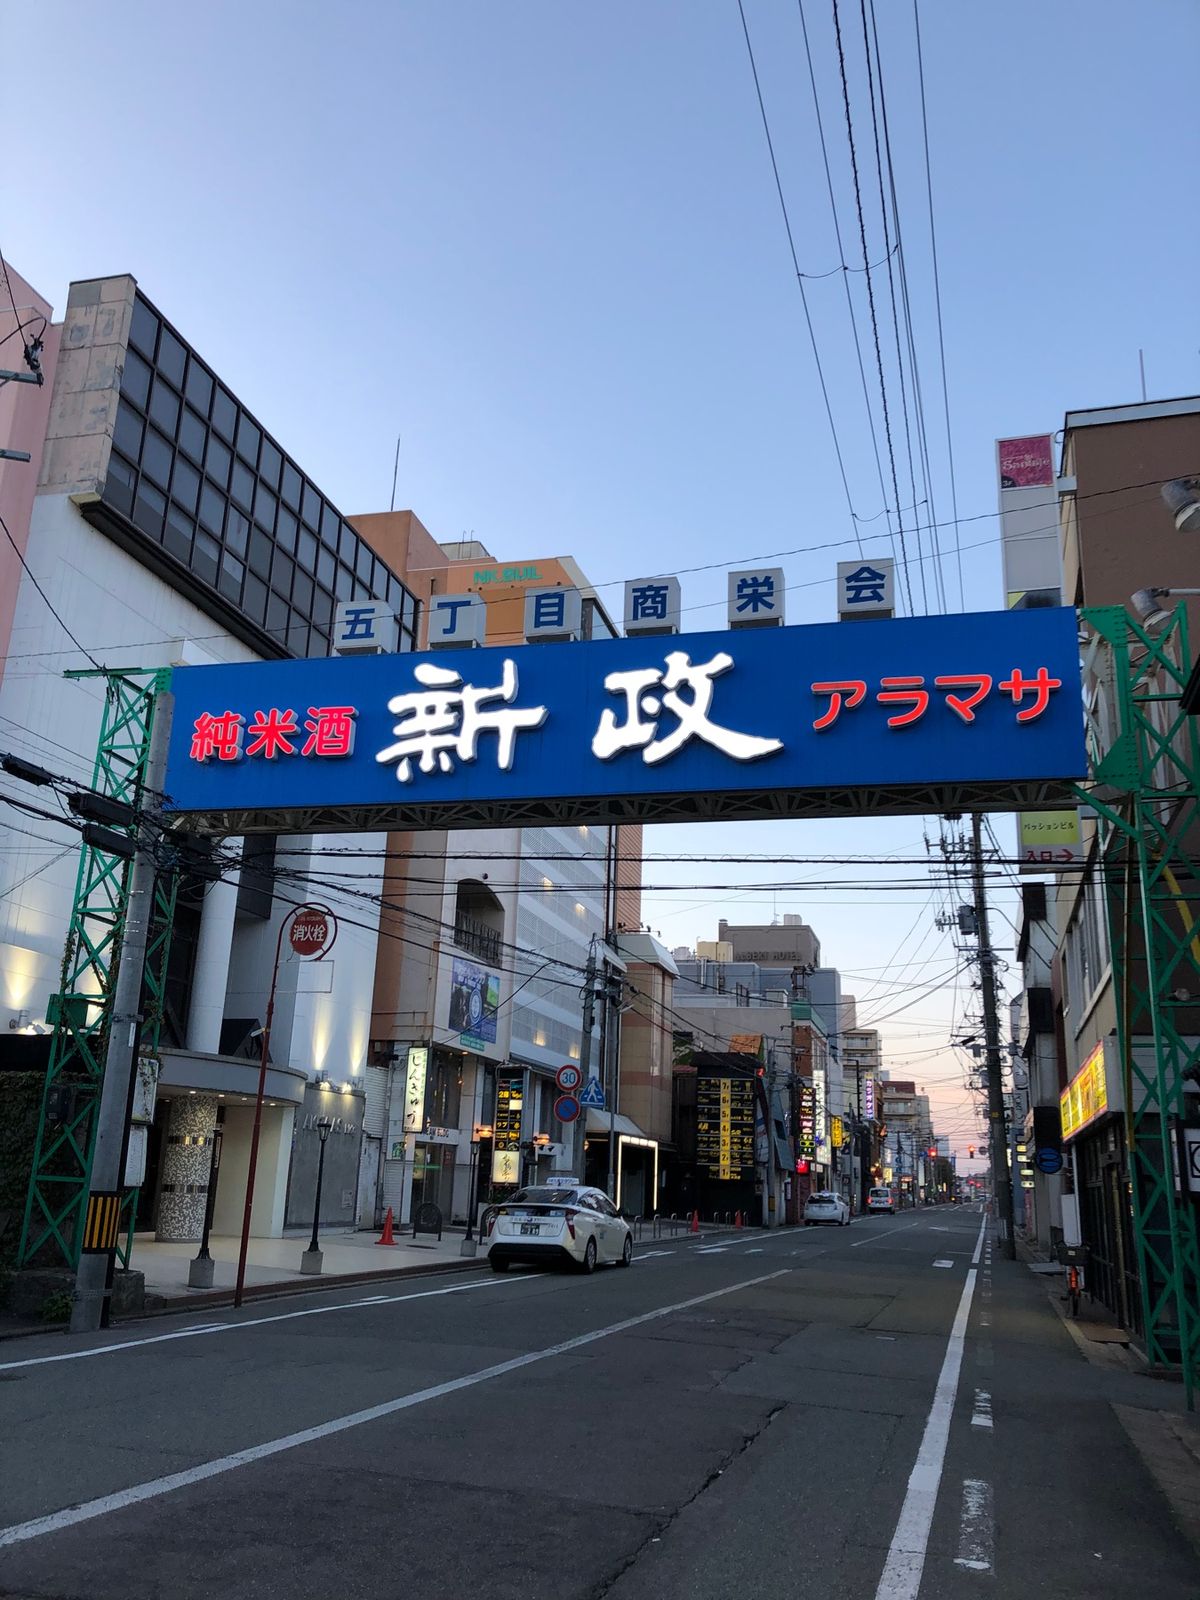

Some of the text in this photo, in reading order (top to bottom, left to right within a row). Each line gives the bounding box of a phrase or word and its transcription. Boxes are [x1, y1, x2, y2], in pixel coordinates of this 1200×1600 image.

[342, 566, 886, 640] 五丁目商栄会
[190, 650, 1063, 783] 純米酒 新政 アラマサ
[292, 924, 326, 942] 消火栓
[562, 1072, 576, 1084] 30
